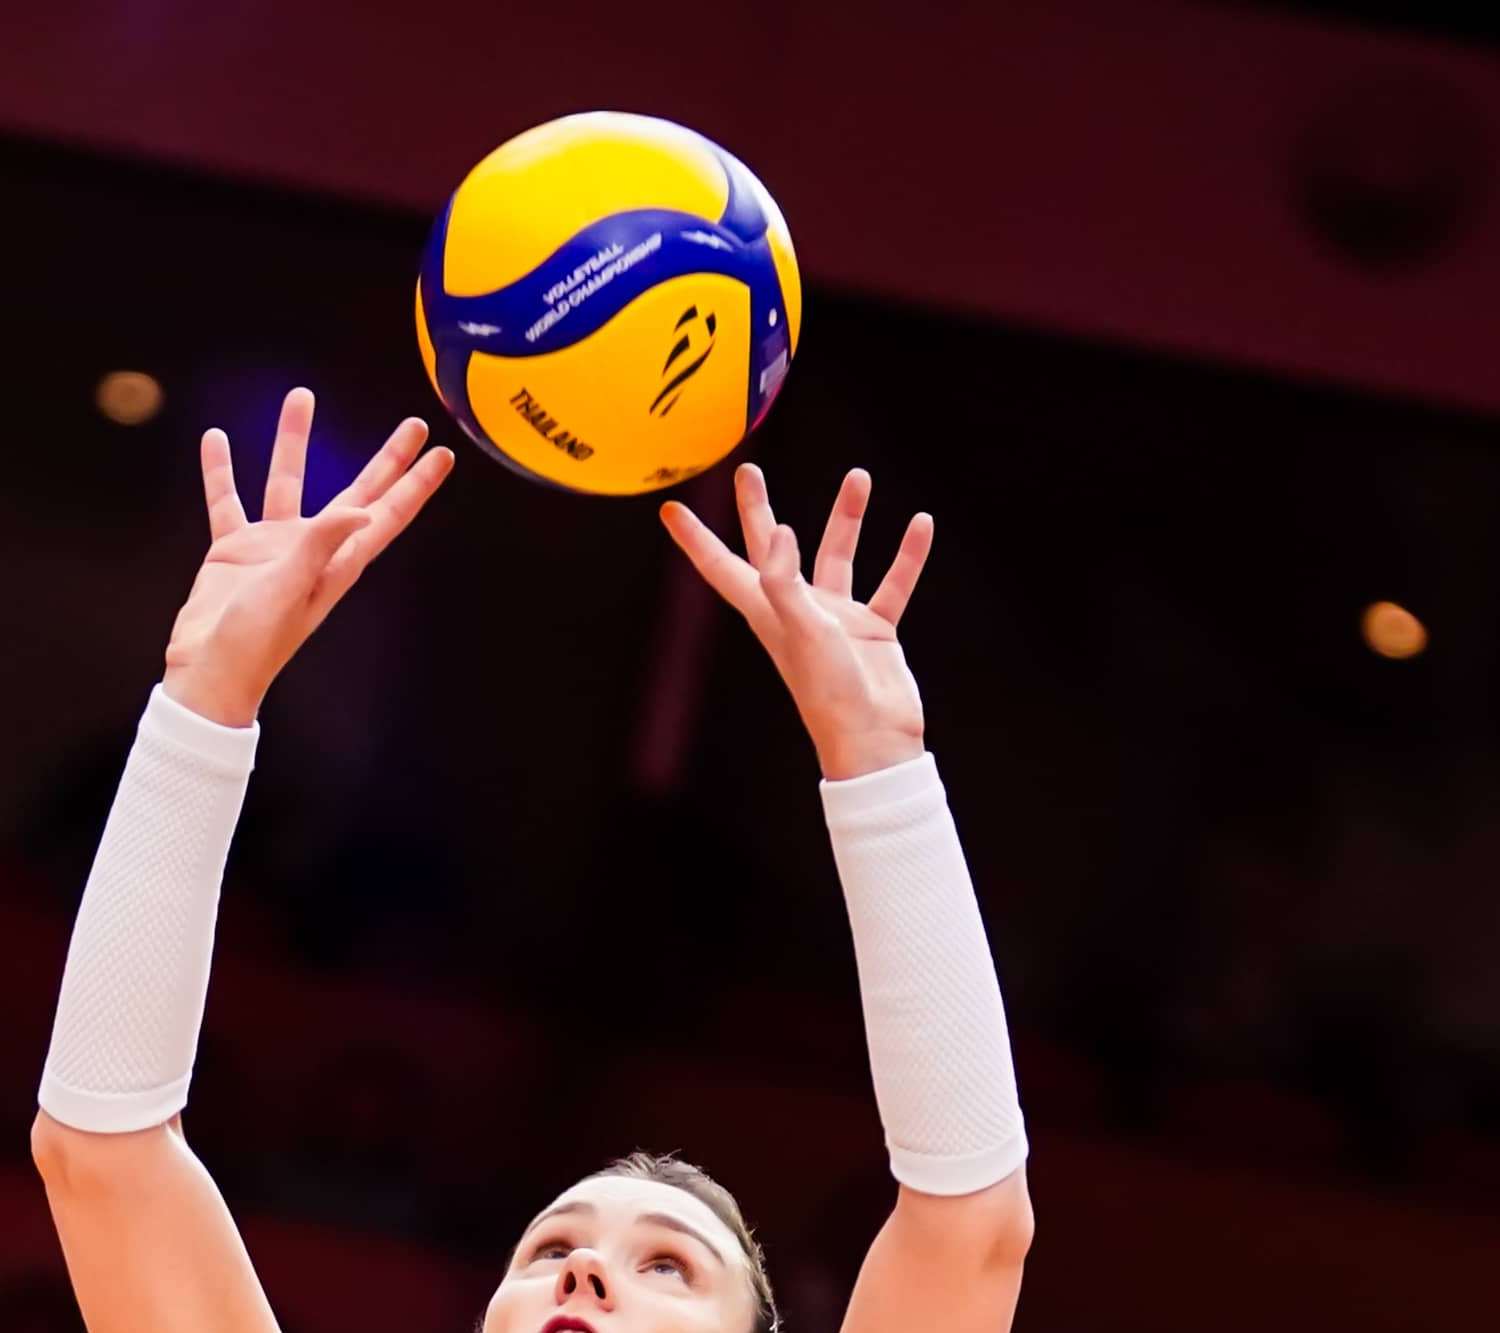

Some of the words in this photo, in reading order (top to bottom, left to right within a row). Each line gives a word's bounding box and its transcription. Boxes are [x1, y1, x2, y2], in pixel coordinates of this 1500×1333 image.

[525, 300, 570, 342] WORLD
[568, 232, 662, 307] CHAMPIONSHIP
[543, 242, 624, 305] VOLLEYBALL
[510, 386, 595, 461] THAILAND
